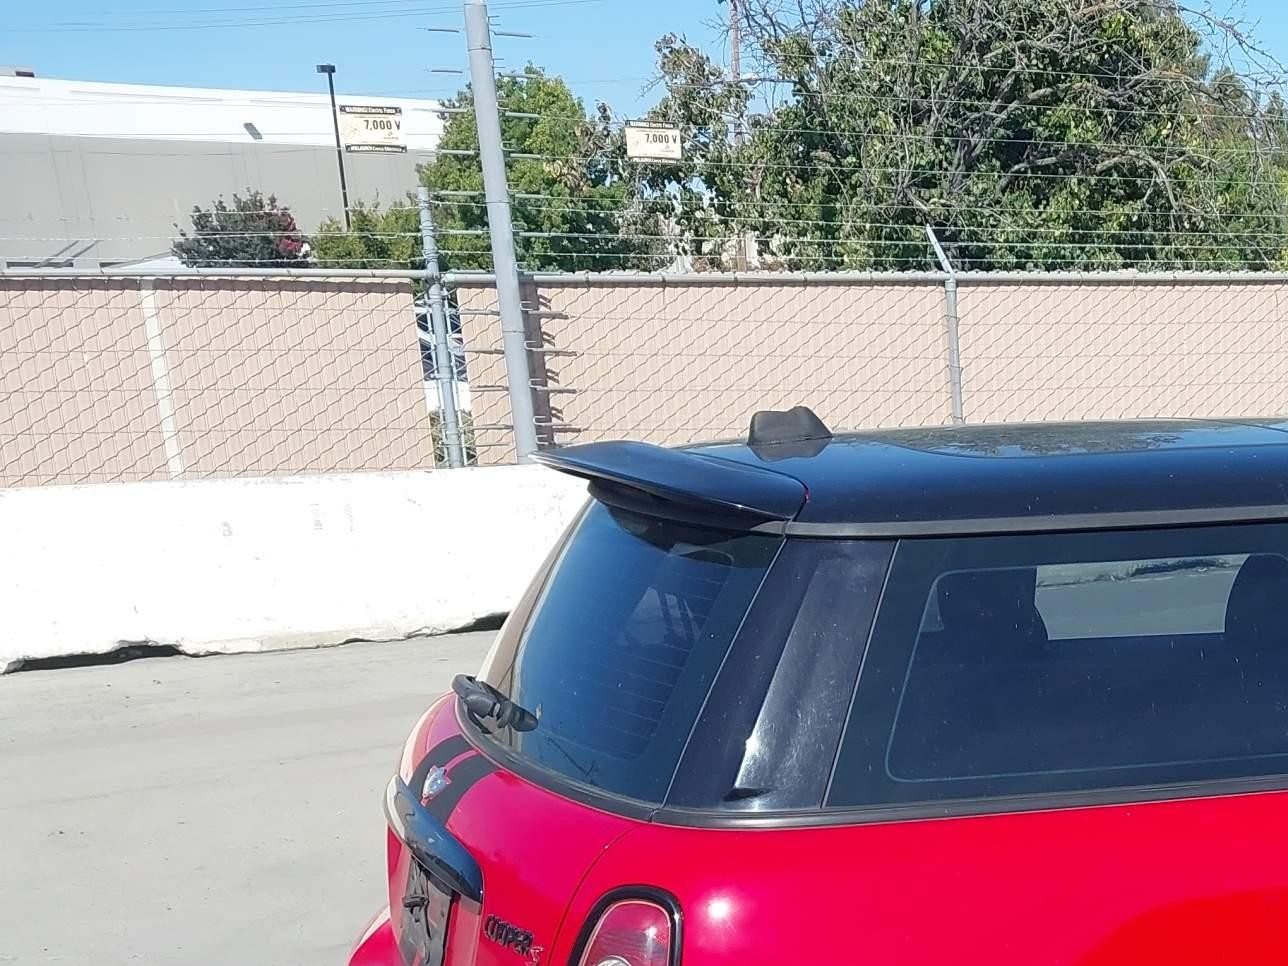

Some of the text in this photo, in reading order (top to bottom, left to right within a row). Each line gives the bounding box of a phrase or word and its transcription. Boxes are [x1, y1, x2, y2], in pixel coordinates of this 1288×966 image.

[363, 120, 401, 131] 7,000 V
[645, 133, 677, 144] 7,000 V
